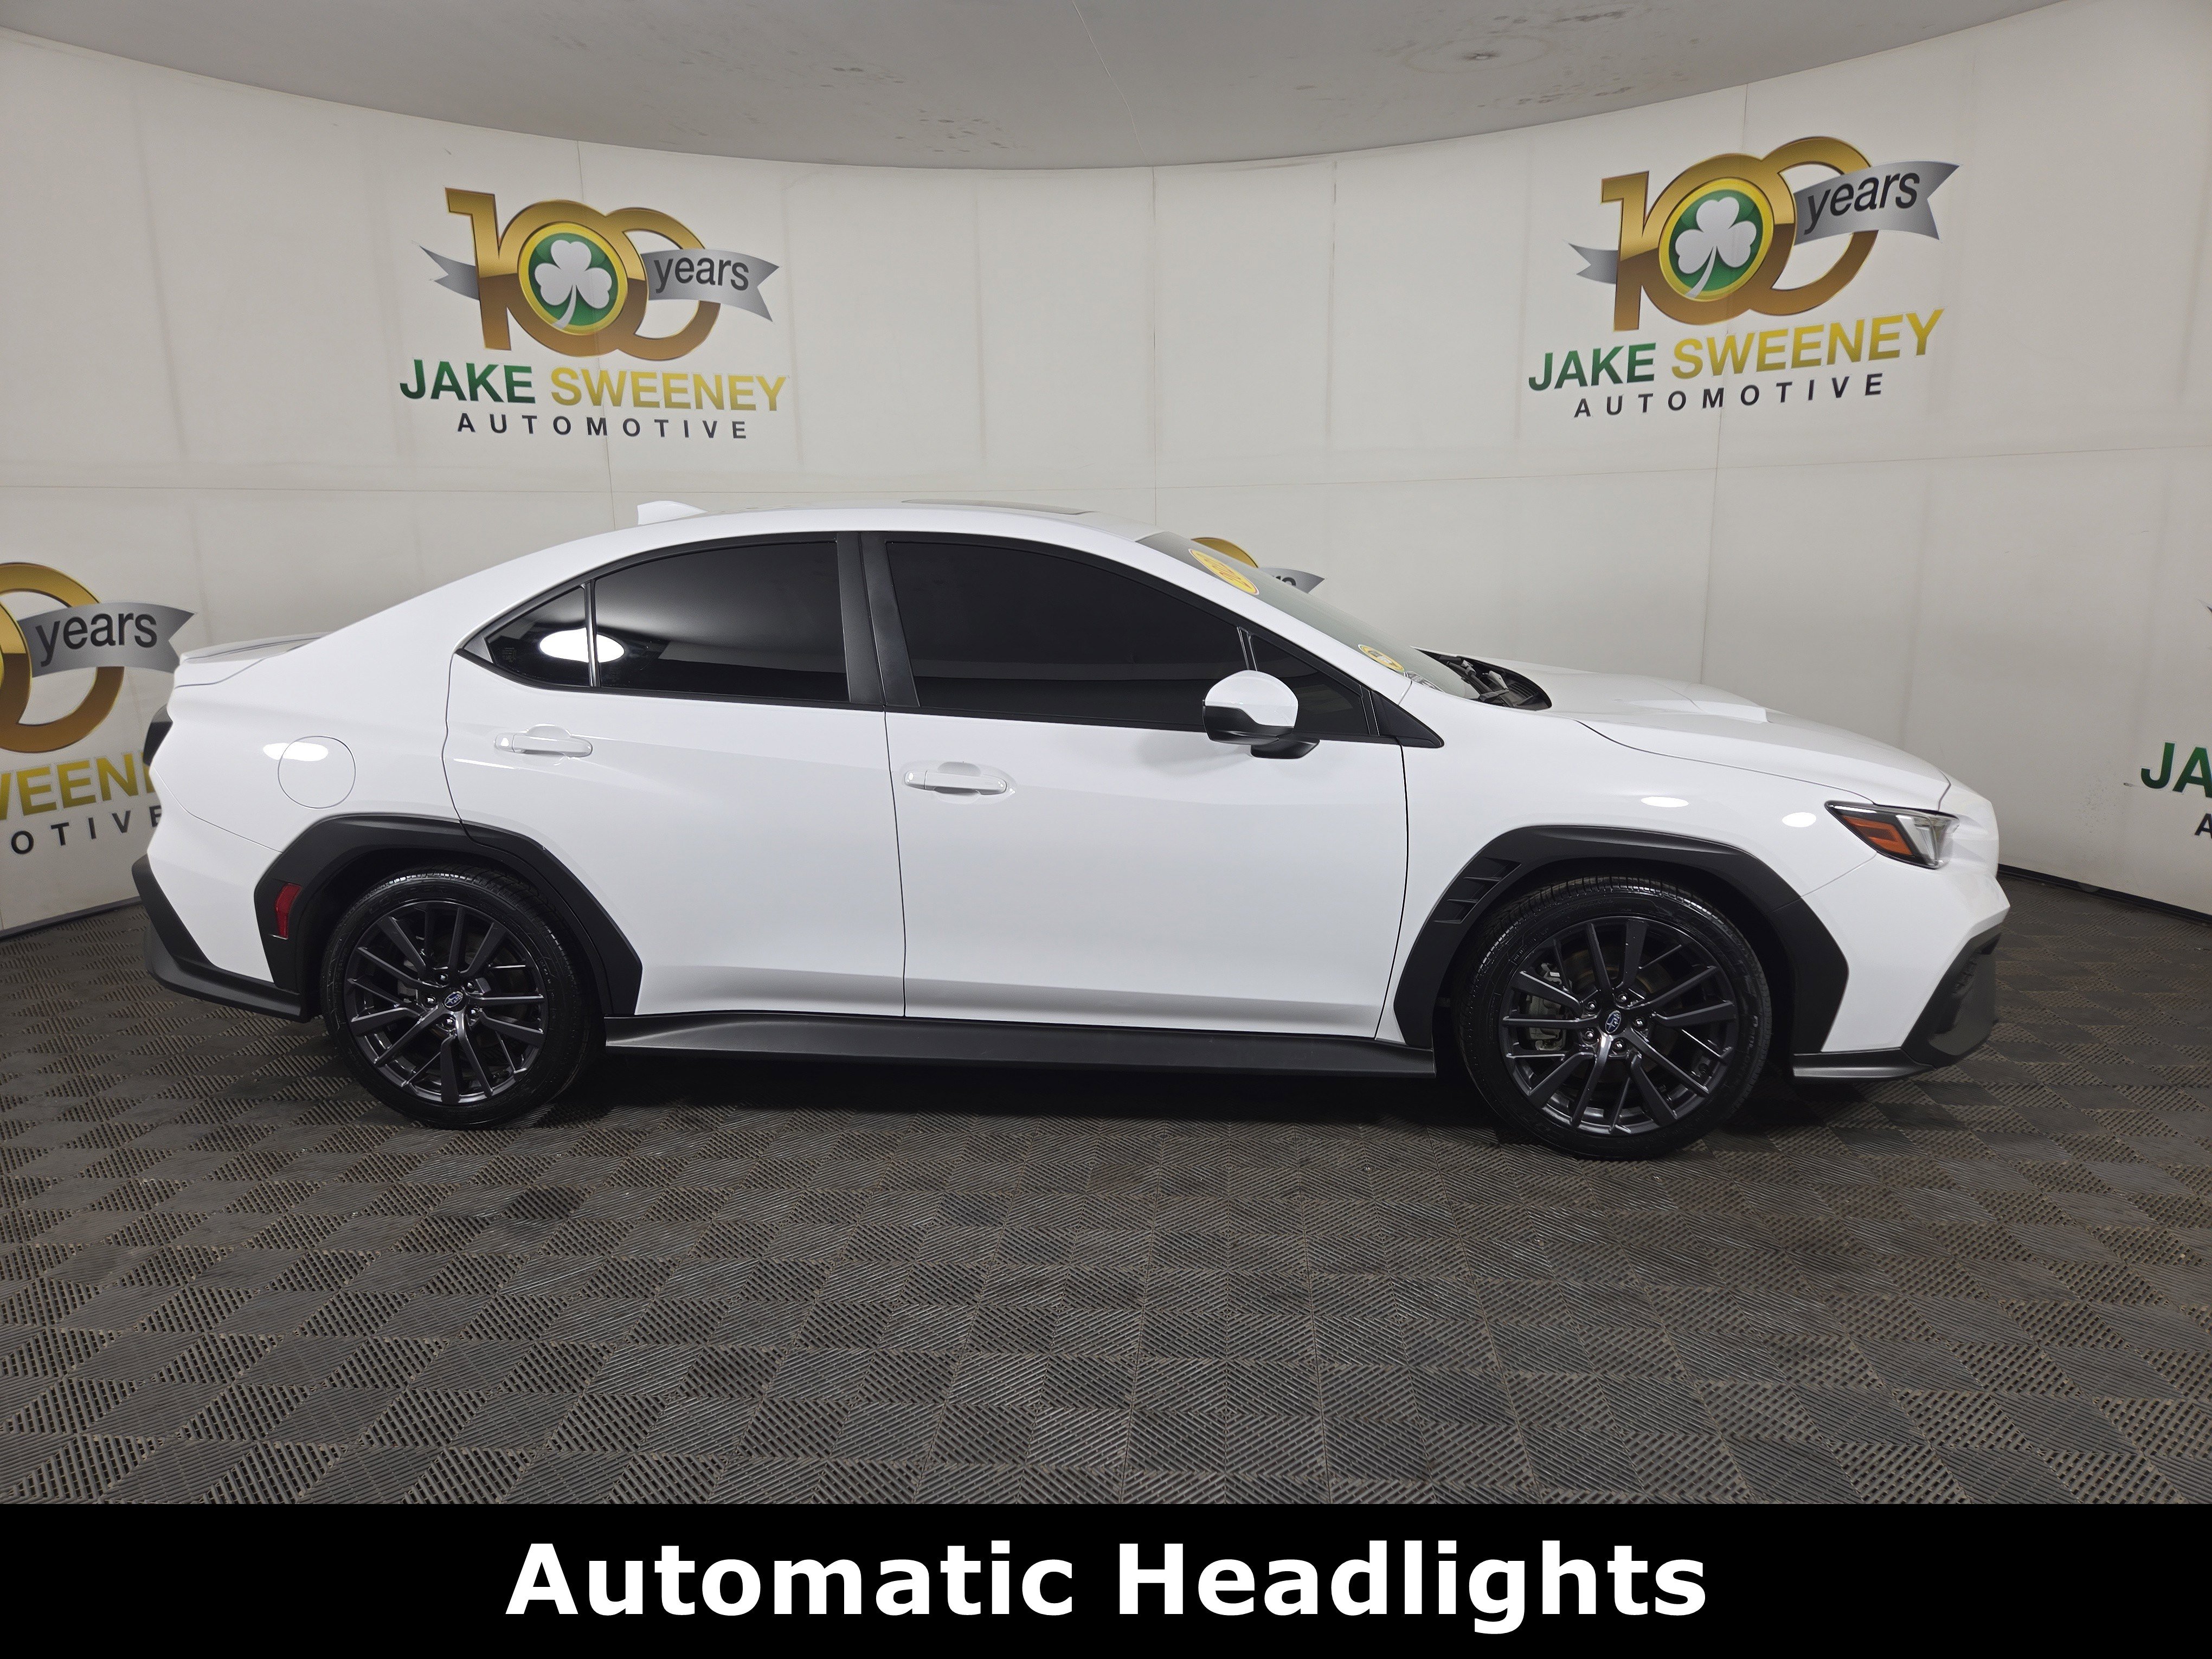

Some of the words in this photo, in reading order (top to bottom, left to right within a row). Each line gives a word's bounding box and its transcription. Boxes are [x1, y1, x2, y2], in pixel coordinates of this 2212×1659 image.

[1804, 170, 1920, 235] years
[653, 255, 749, 293] years
[1529, 343, 1656, 391] JAKE
[1672, 308, 1945, 380] SWEENEY
[400, 359, 536, 404] JAKE
[551, 367, 787, 411] SWEENEY
[1574, 373, 1883, 419] AUTOMOTIVE
[457, 413, 747, 439] AUTOMOTIVE
[36, 612, 158, 667] years
